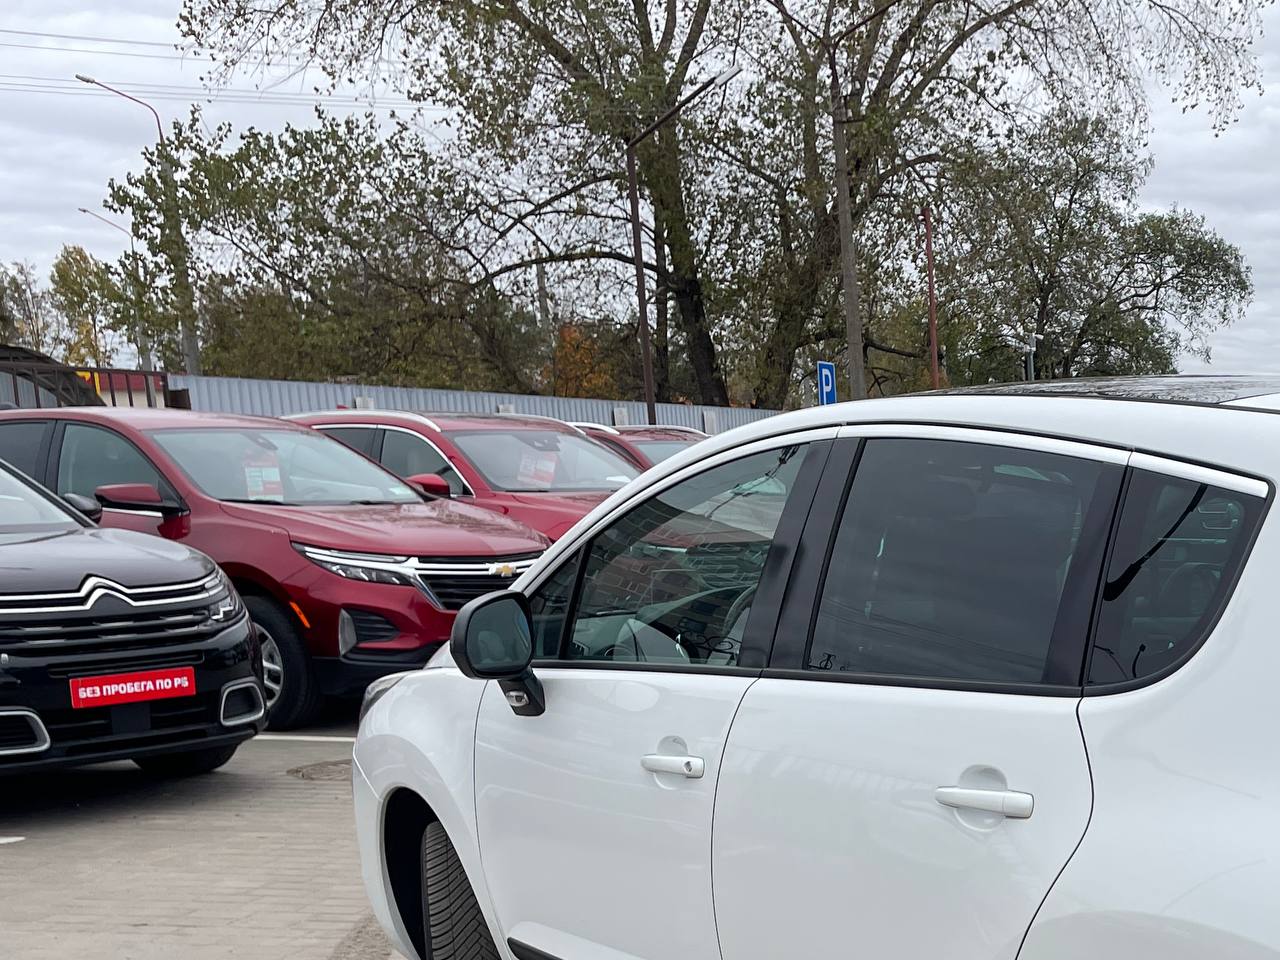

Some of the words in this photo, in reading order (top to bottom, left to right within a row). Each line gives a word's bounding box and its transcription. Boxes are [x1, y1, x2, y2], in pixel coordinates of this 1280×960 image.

[78, 687, 101, 699] БЕЗ
[102, 681, 155, 696] ПРОБЕГА
[156, 677, 172, 690] ПО
